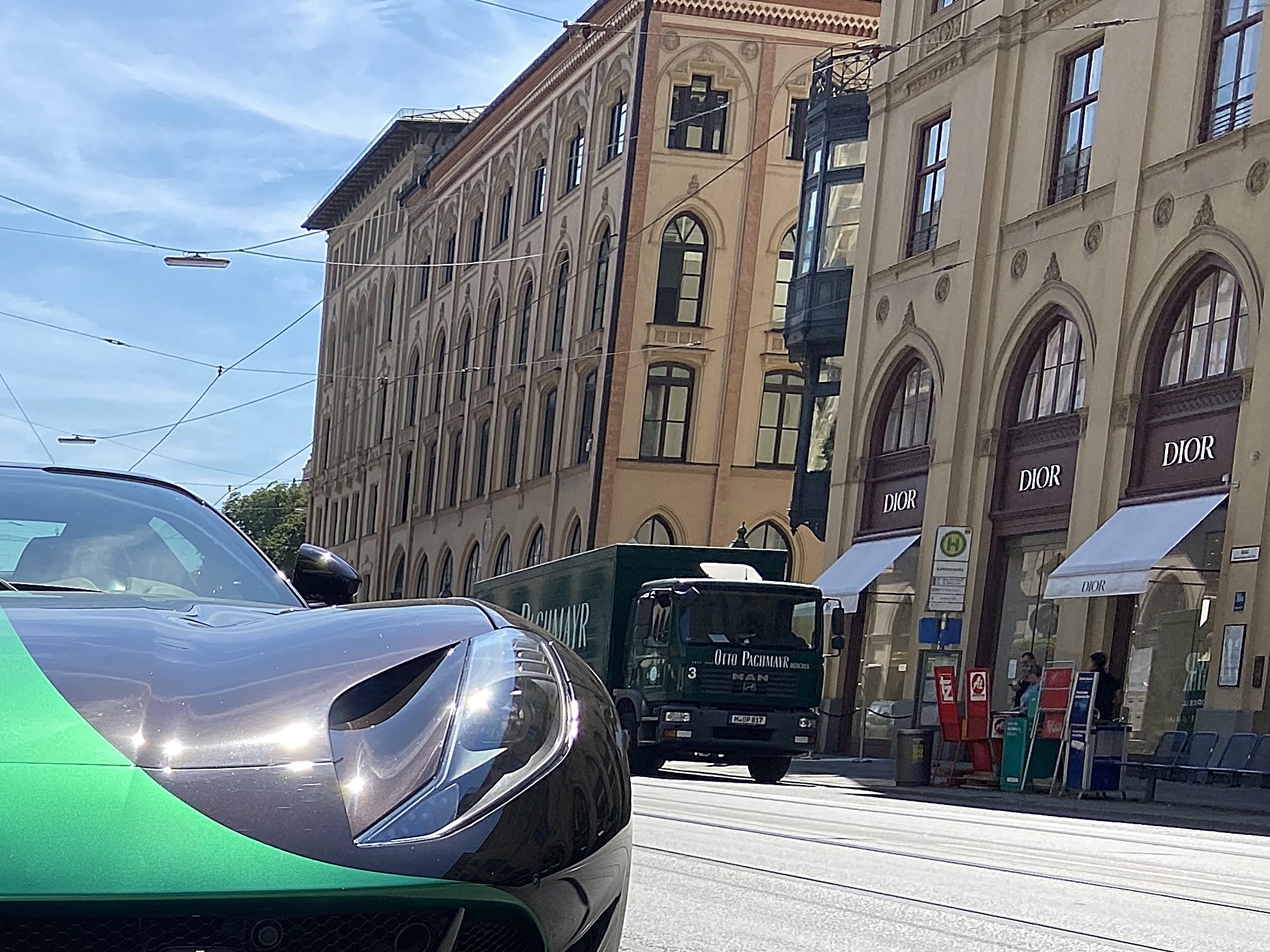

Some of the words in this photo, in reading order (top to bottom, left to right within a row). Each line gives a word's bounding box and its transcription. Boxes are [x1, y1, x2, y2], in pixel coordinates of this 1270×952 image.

[1161, 434, 1215, 467] DIOR
[1018, 464, 1061, 492] DIOR
[883, 489, 917, 513] DIOR
[946, 536, 960, 552] H
[1081, 579, 1106, 592] DIOR
[521, 602, 590, 650] MAYR
[687, 666, 697, 679] 3
[732, 672, 769, 682] MAN
